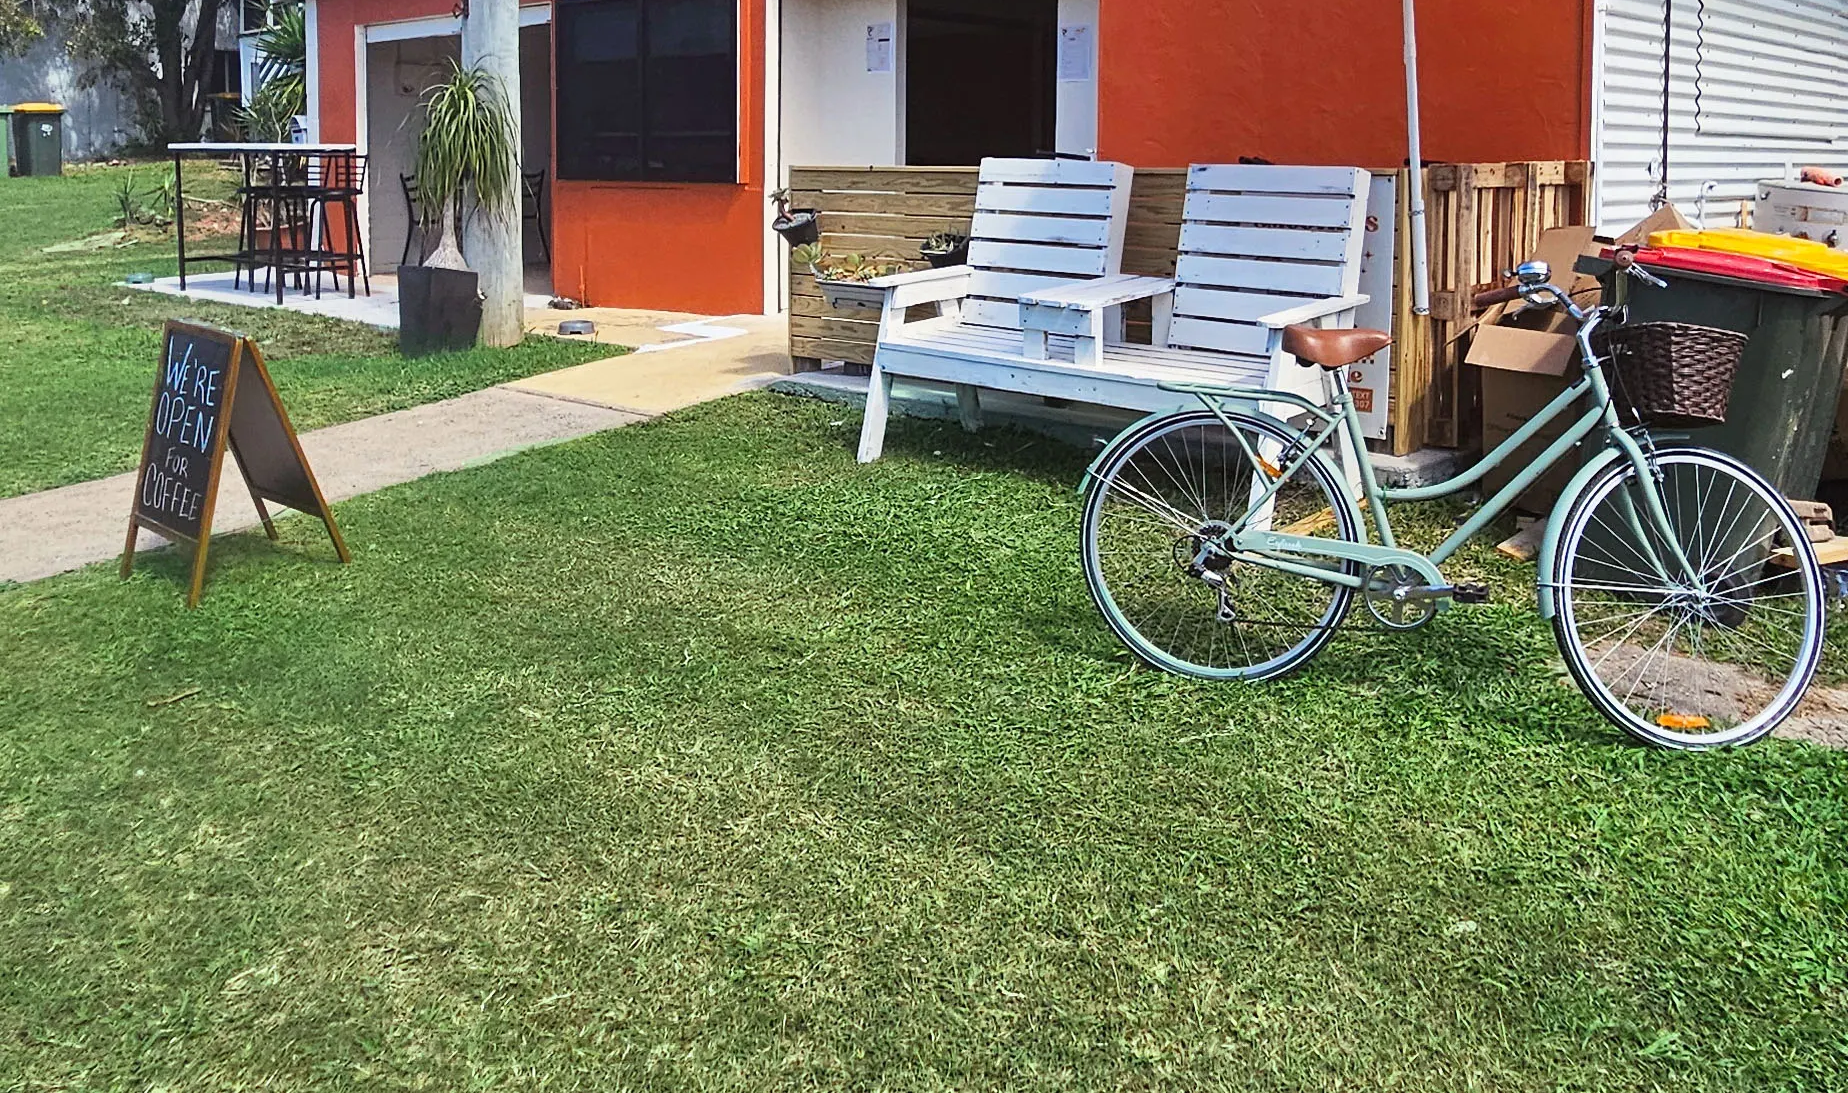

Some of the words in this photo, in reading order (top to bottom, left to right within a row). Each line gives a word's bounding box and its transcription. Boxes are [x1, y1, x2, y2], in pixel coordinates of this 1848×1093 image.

[165, 335, 221, 406] WE'RE
[156, 391, 214, 454] OPEN
[142, 462, 202, 520] COFFEE
[165, 447, 189, 478] FOR
